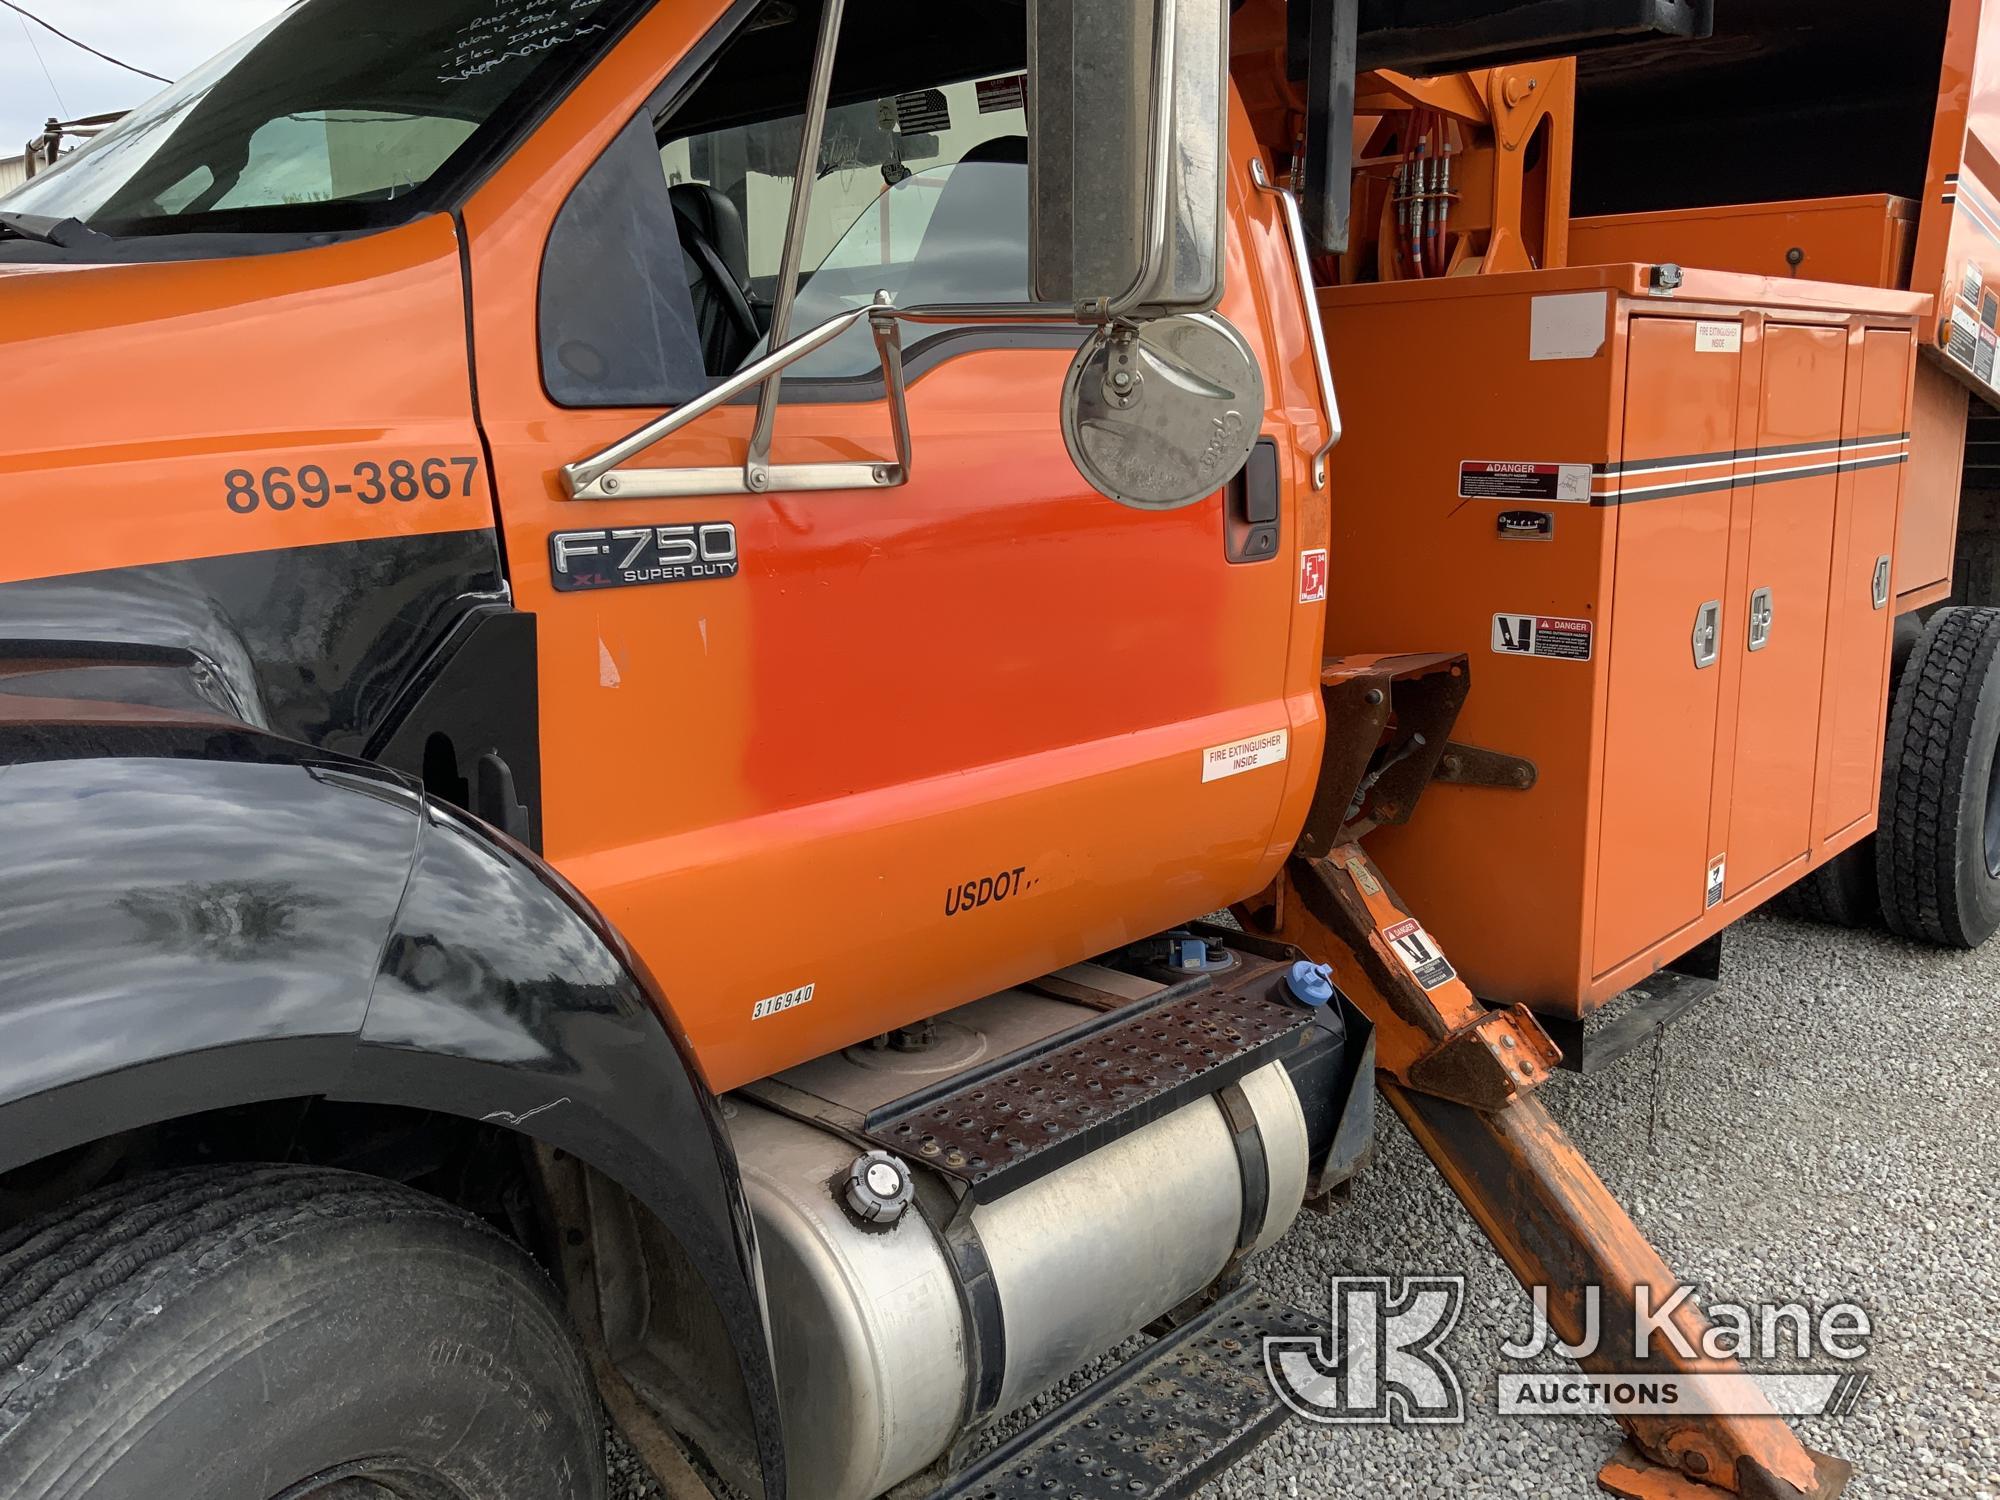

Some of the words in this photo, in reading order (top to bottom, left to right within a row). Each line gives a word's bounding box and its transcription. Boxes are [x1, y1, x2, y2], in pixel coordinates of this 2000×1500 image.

[1494, 463, 1536, 473] DANGER
[224, 456, 479, 514] 869-3867
[572, 574, 612, 586] XL
[624, 566, 686, 582] SUPER
[691, 562, 737, 576] DUTY
[1554, 621, 1587, 631] DANGER
[1209, 749, 1227, 764] FIRE
[1228, 735, 1281, 758] EXTINGUISHER
[1233, 754, 1258, 770] INSIDE
[754, 986, 813, 1017] 316940
